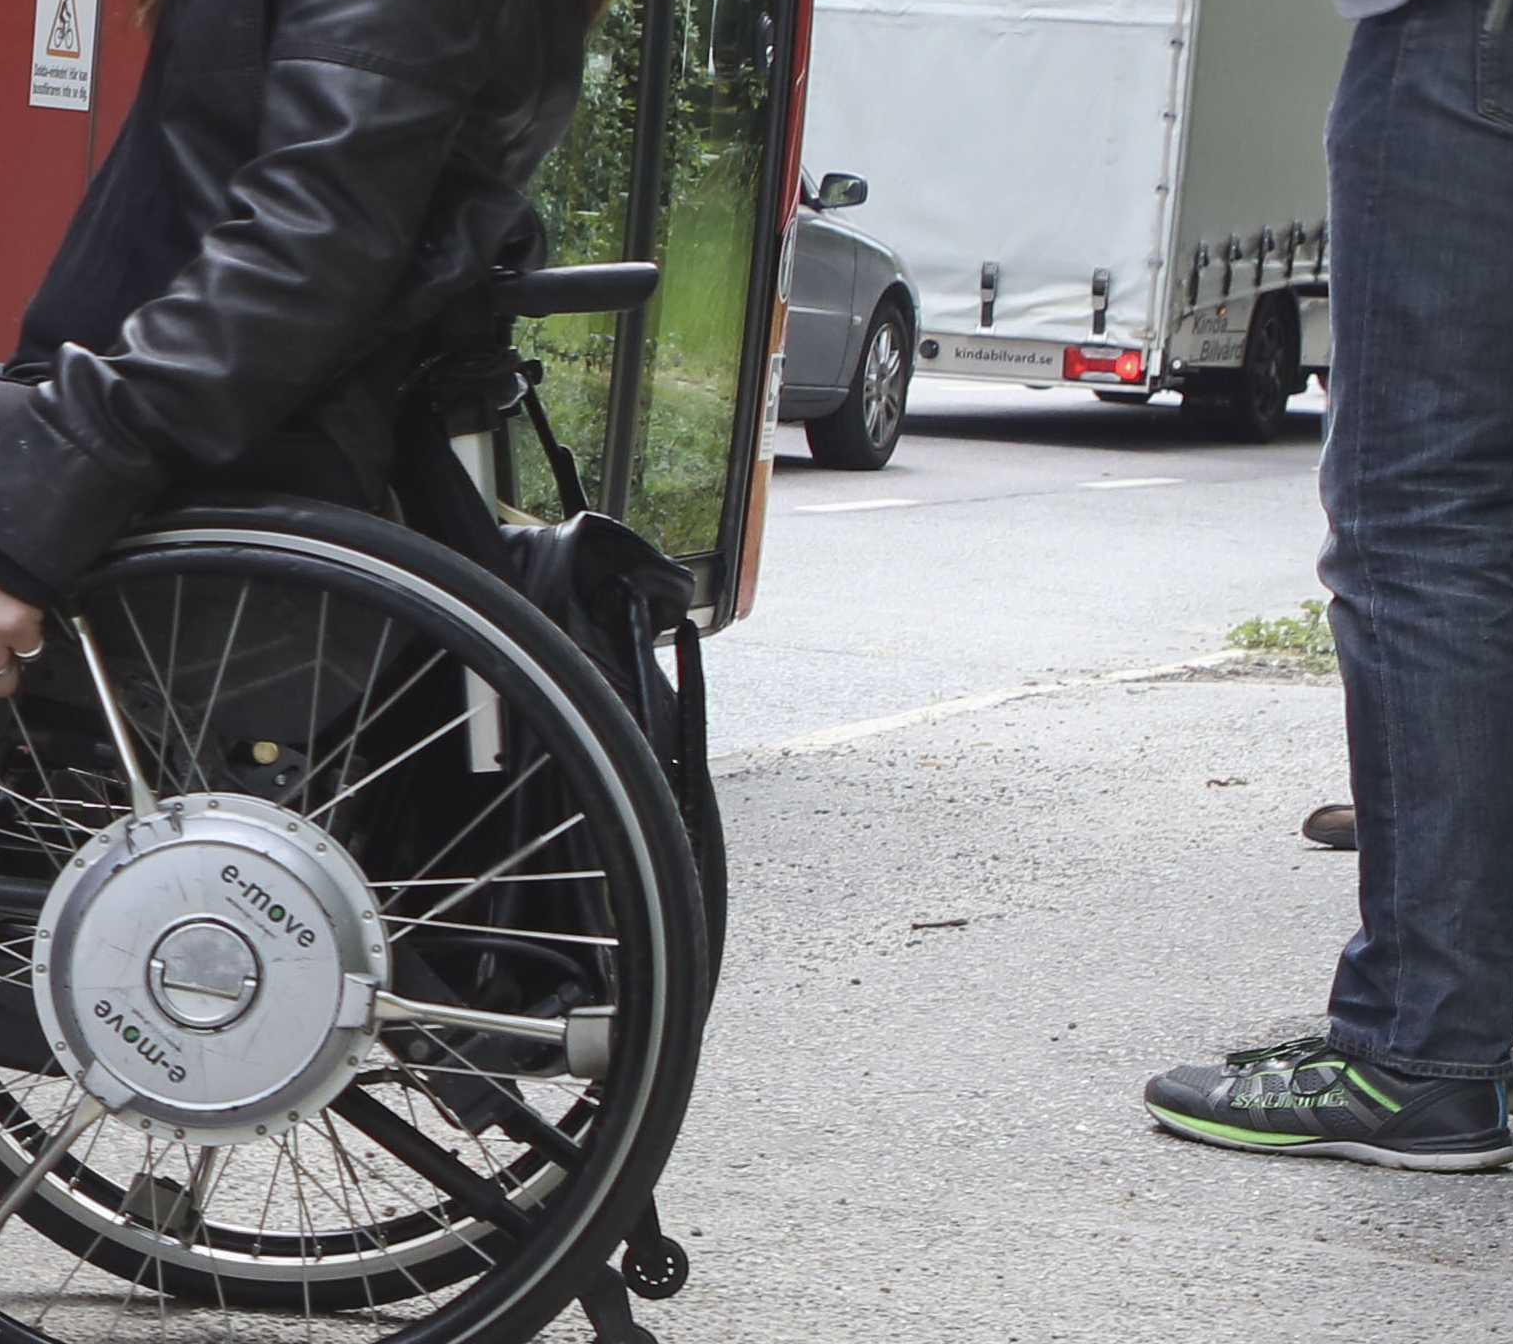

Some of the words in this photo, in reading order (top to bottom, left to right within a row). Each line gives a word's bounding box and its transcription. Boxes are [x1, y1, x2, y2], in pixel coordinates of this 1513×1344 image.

[954, 347, 1054, 365] kindabilvard.se
[221, 863, 316, 948] e-move
[94, 999, 187, 1084] e-move
